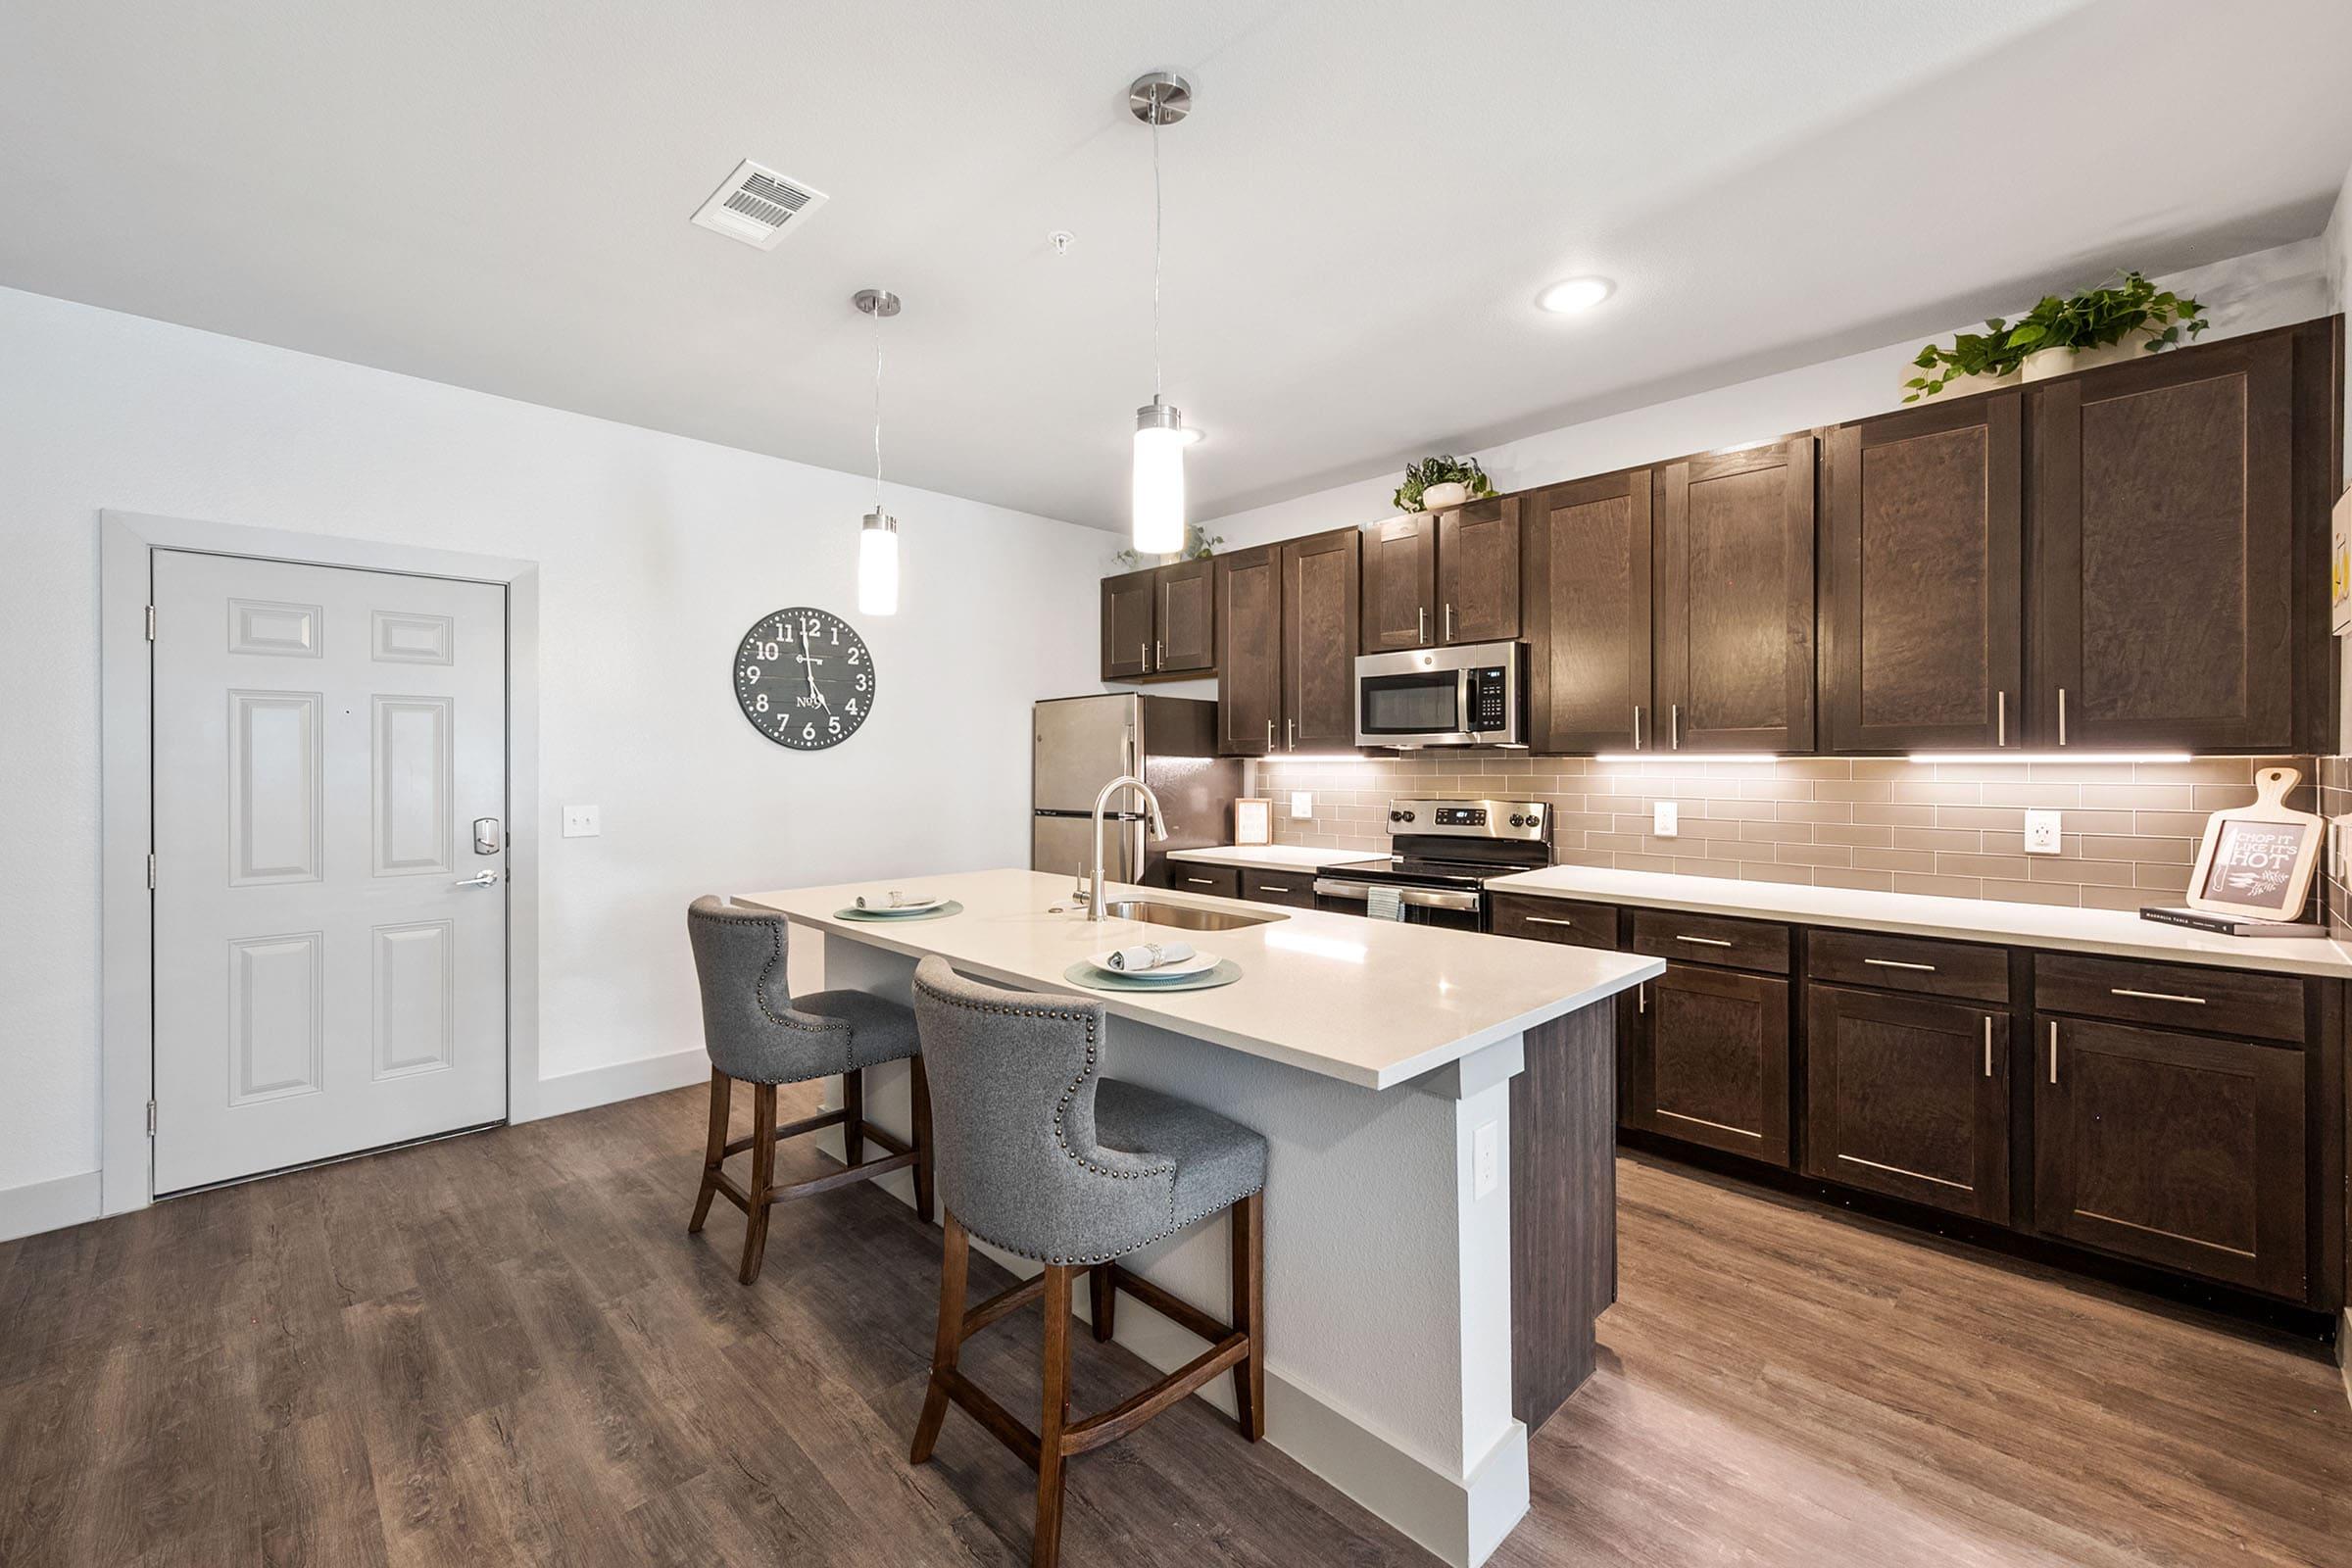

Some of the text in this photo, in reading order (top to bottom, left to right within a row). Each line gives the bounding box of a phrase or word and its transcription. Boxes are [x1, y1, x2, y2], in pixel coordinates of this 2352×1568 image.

[776, 623, 794, 642] 11
[800, 618, 821, 637] 12
[830, 627, 839, 645] 1
[756, 642, 779, 661] 10
[847, 647, 859, 664] 2
[747, 665, 760, 684] 9
[856, 673, 867, 691] 3
[756, 694, 769, 711] 8
[845, 698, 858, 715] 4
[776, 713, 790, 732] 7
[803, 722, 815, 740] 6
[828, 716, 841, 734] 5
[2237, 832, 2294, 845] CHOP IT
[2233, 842, 2298, 855] LIKE IT'S
[2230, 850, 2290, 869] HOT
